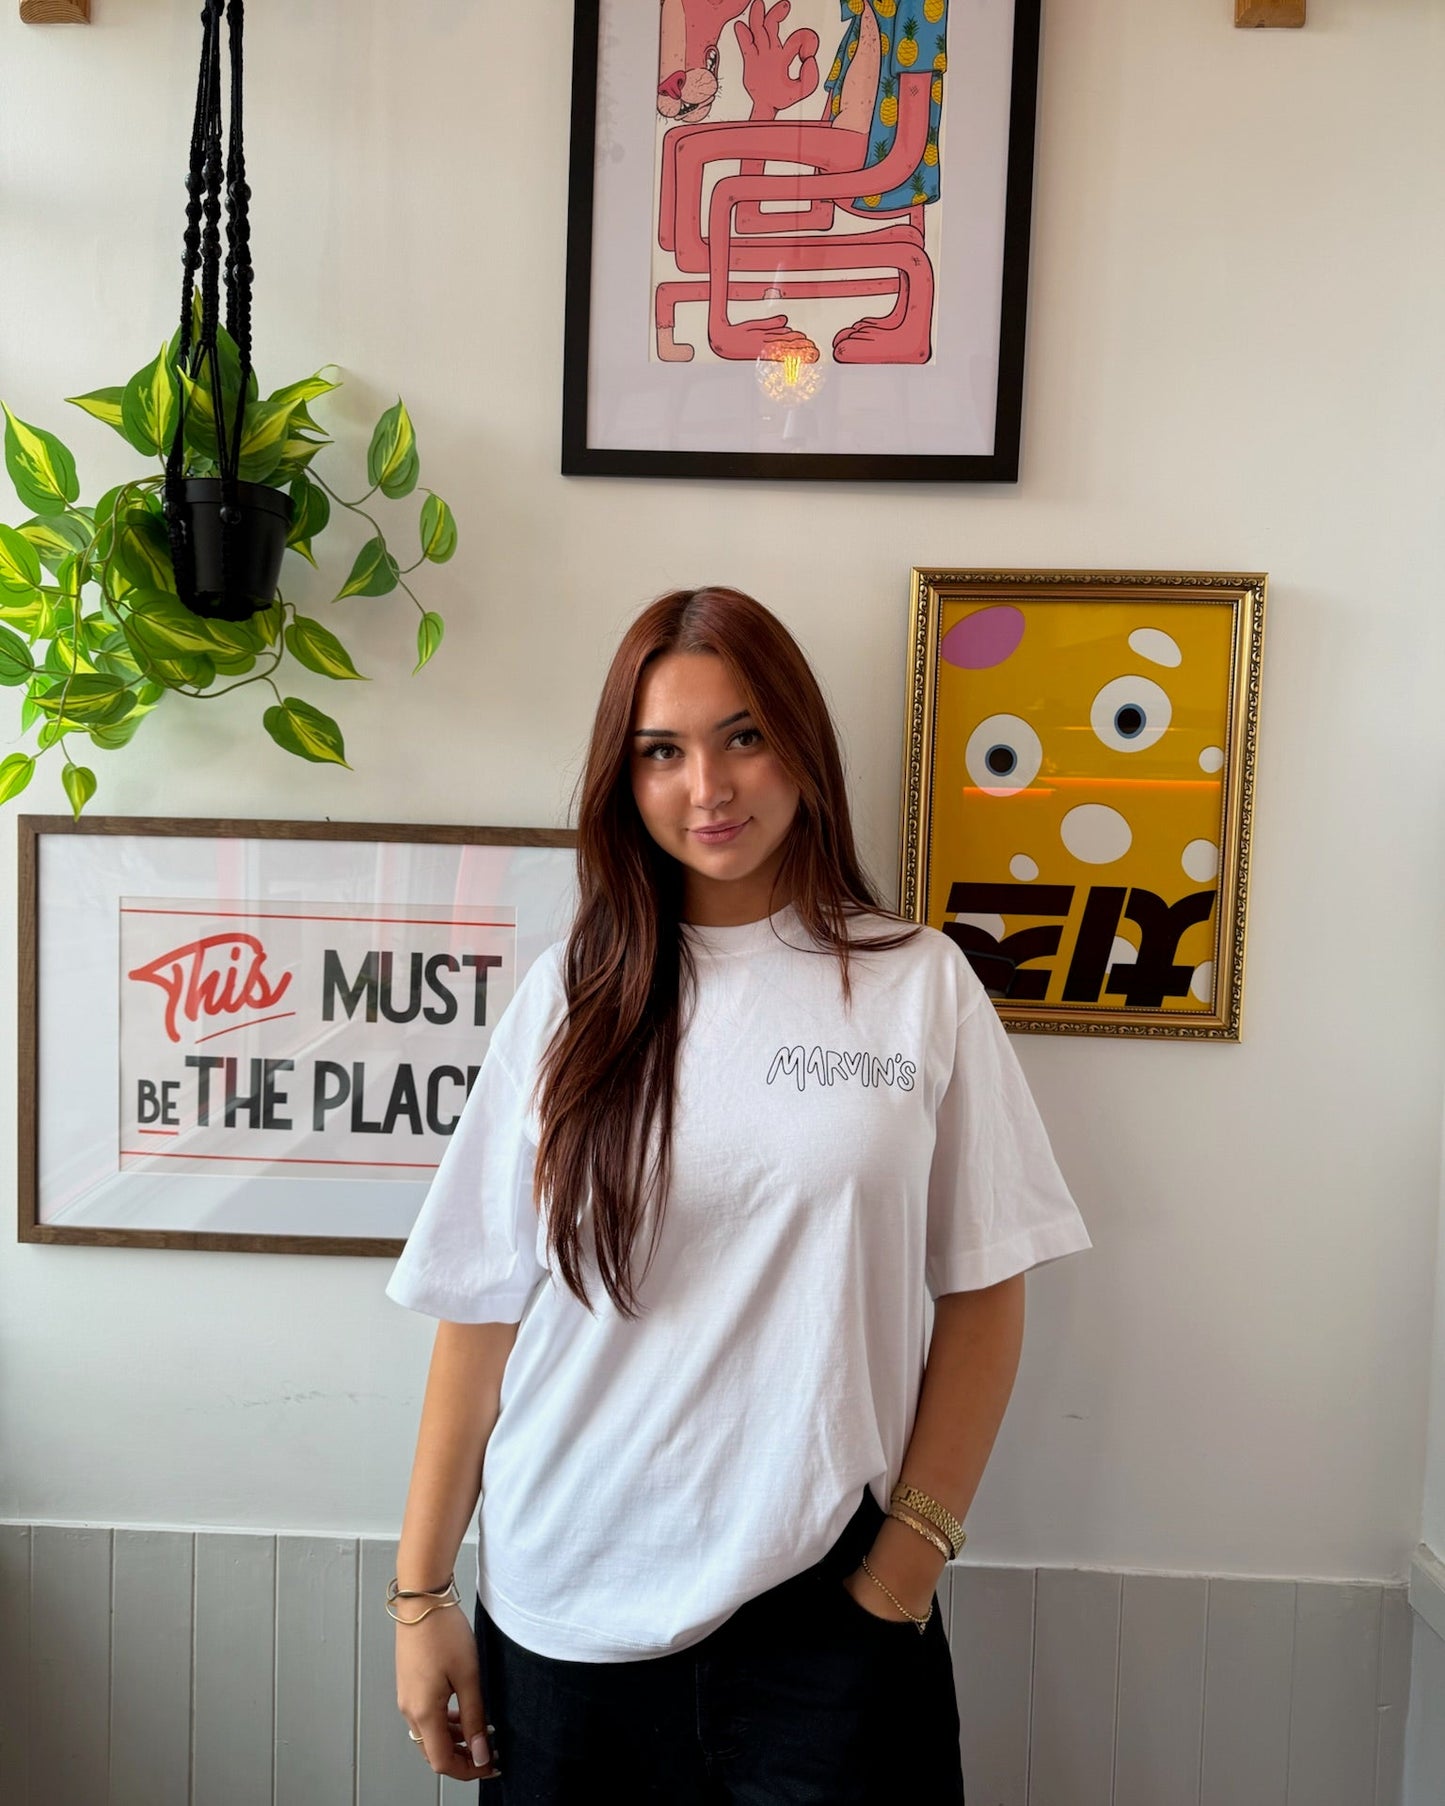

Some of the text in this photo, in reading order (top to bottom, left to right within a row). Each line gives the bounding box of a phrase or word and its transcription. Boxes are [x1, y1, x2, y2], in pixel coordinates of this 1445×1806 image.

[128, 933, 503, 1043] This MUST
[137, 1055, 482, 1136] BE THE PLAC
[766, 1045, 917, 1092] MARVIN'S
